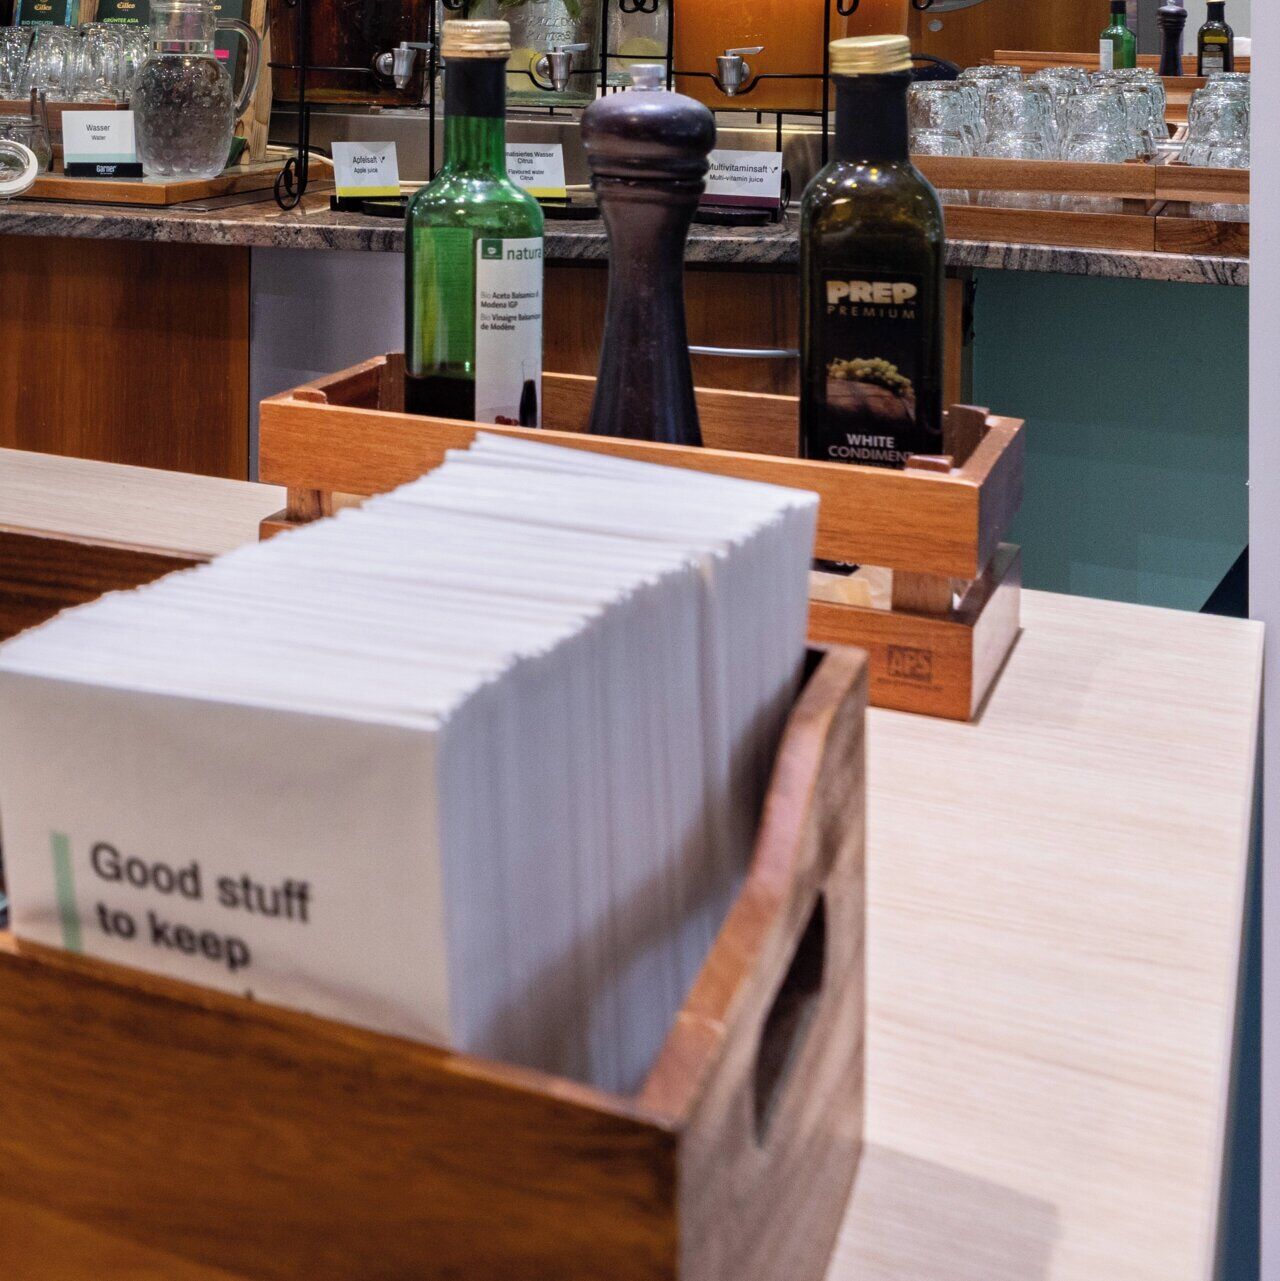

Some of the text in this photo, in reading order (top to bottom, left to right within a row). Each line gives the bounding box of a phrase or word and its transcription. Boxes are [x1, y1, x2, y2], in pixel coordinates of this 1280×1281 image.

[352, 156, 378, 165] Apfelsaft
[710, 174, 747, 182] Multi-vitamin
[826, 280, 917, 304] PREP
[827, 306, 915, 319] PREMIUM
[847, 433, 895, 449] WHITE
[91, 840, 311, 924] Good stuff
[96, 900, 252, 972] to keep
